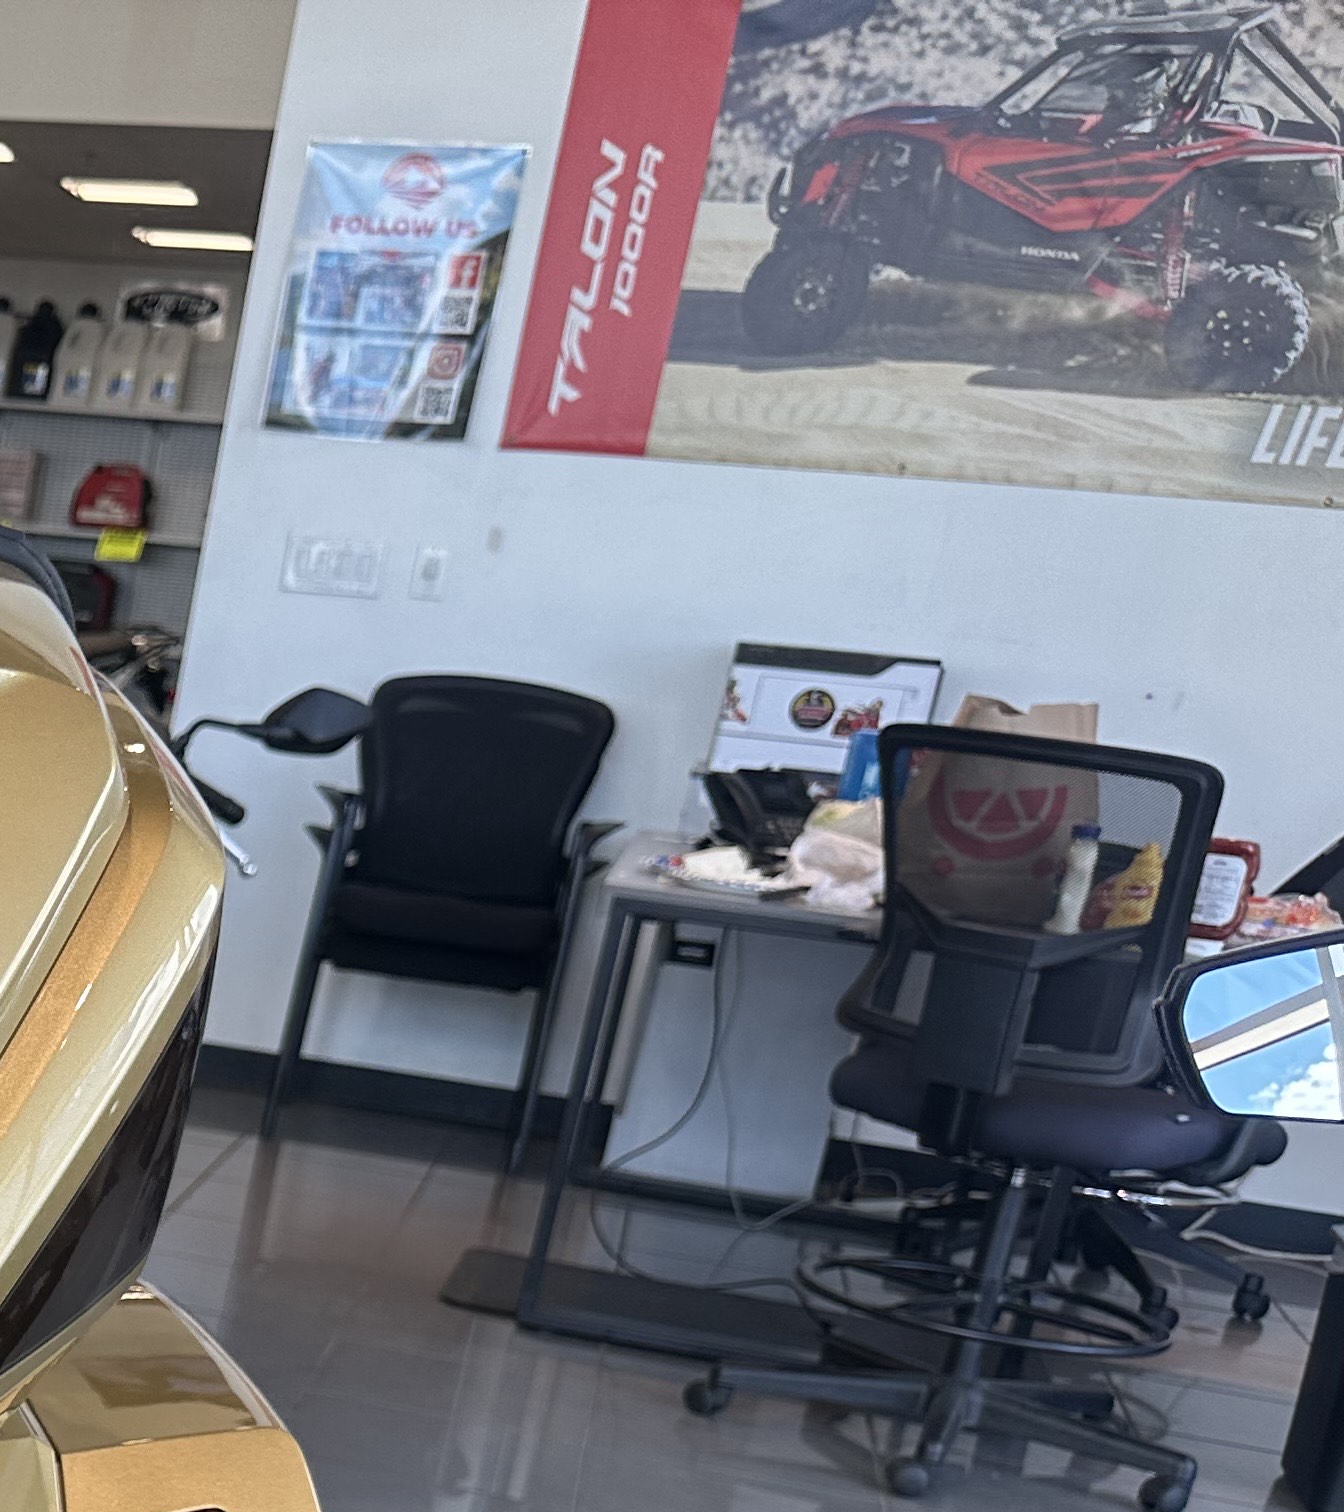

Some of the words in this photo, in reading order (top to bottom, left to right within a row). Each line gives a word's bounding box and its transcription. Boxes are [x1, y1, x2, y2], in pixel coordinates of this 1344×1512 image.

[329, 214, 437, 238] FOLLOW
[444, 219, 479, 239] US
[547, 137, 627, 416] TALON
[609, 143, 665, 318] 1000R
[1020, 246, 1080, 261] HONDA
